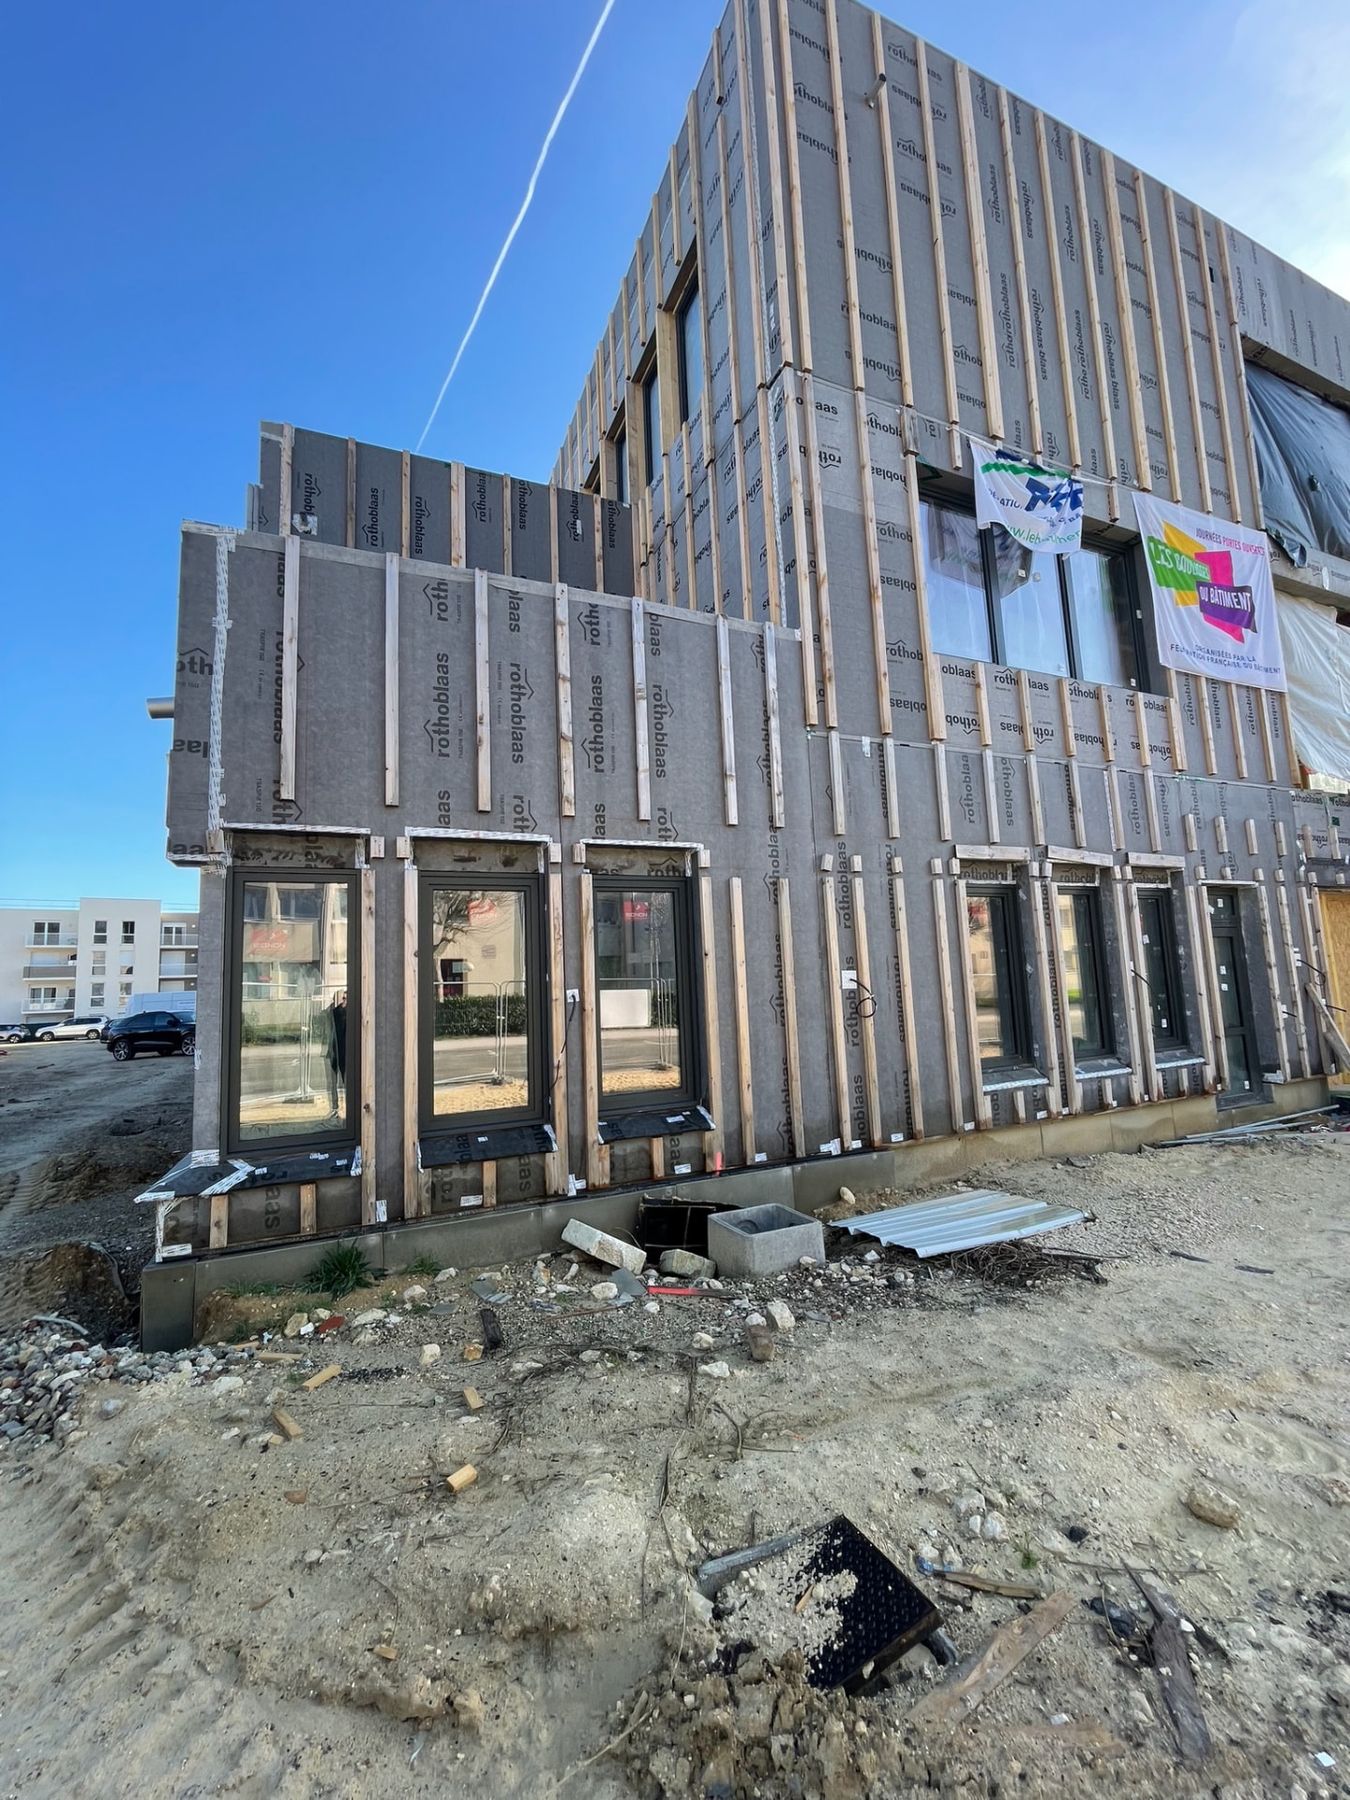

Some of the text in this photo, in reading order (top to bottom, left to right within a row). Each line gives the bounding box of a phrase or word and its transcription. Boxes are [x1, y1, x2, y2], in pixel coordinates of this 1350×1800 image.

[369, 487, 379, 546] rothoblaas
[415, 496, 426, 554] rothoblaas
[1149, 543, 1173, 568] LES
[433, 652, 450, 758] rothoblaas
[510, 662, 527, 764] rothoblaas
[589, 675, 604, 773] rothoblaas
[653, 684, 669, 779] rothoblaas
[838, 841, 851, 929] rothoblaas
